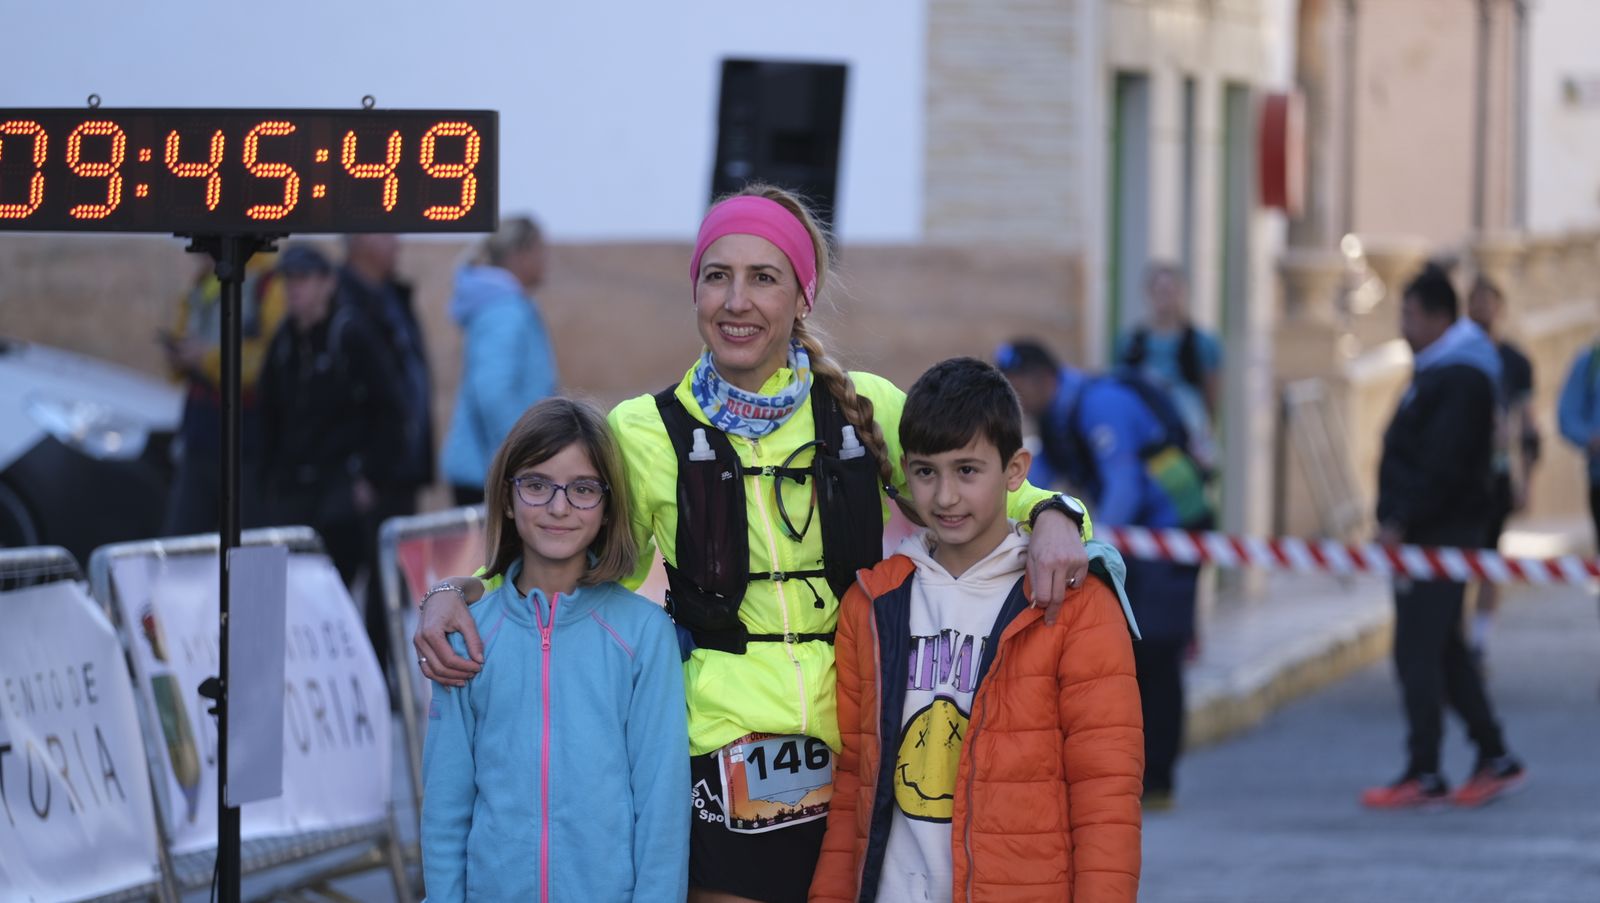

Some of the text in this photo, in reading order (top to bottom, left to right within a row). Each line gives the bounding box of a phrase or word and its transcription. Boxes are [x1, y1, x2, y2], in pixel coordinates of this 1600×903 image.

[0, 120, 481, 221] 09:45:49
[0, 668, 64, 719] ENTO
[746, 737, 830, 780] 146
